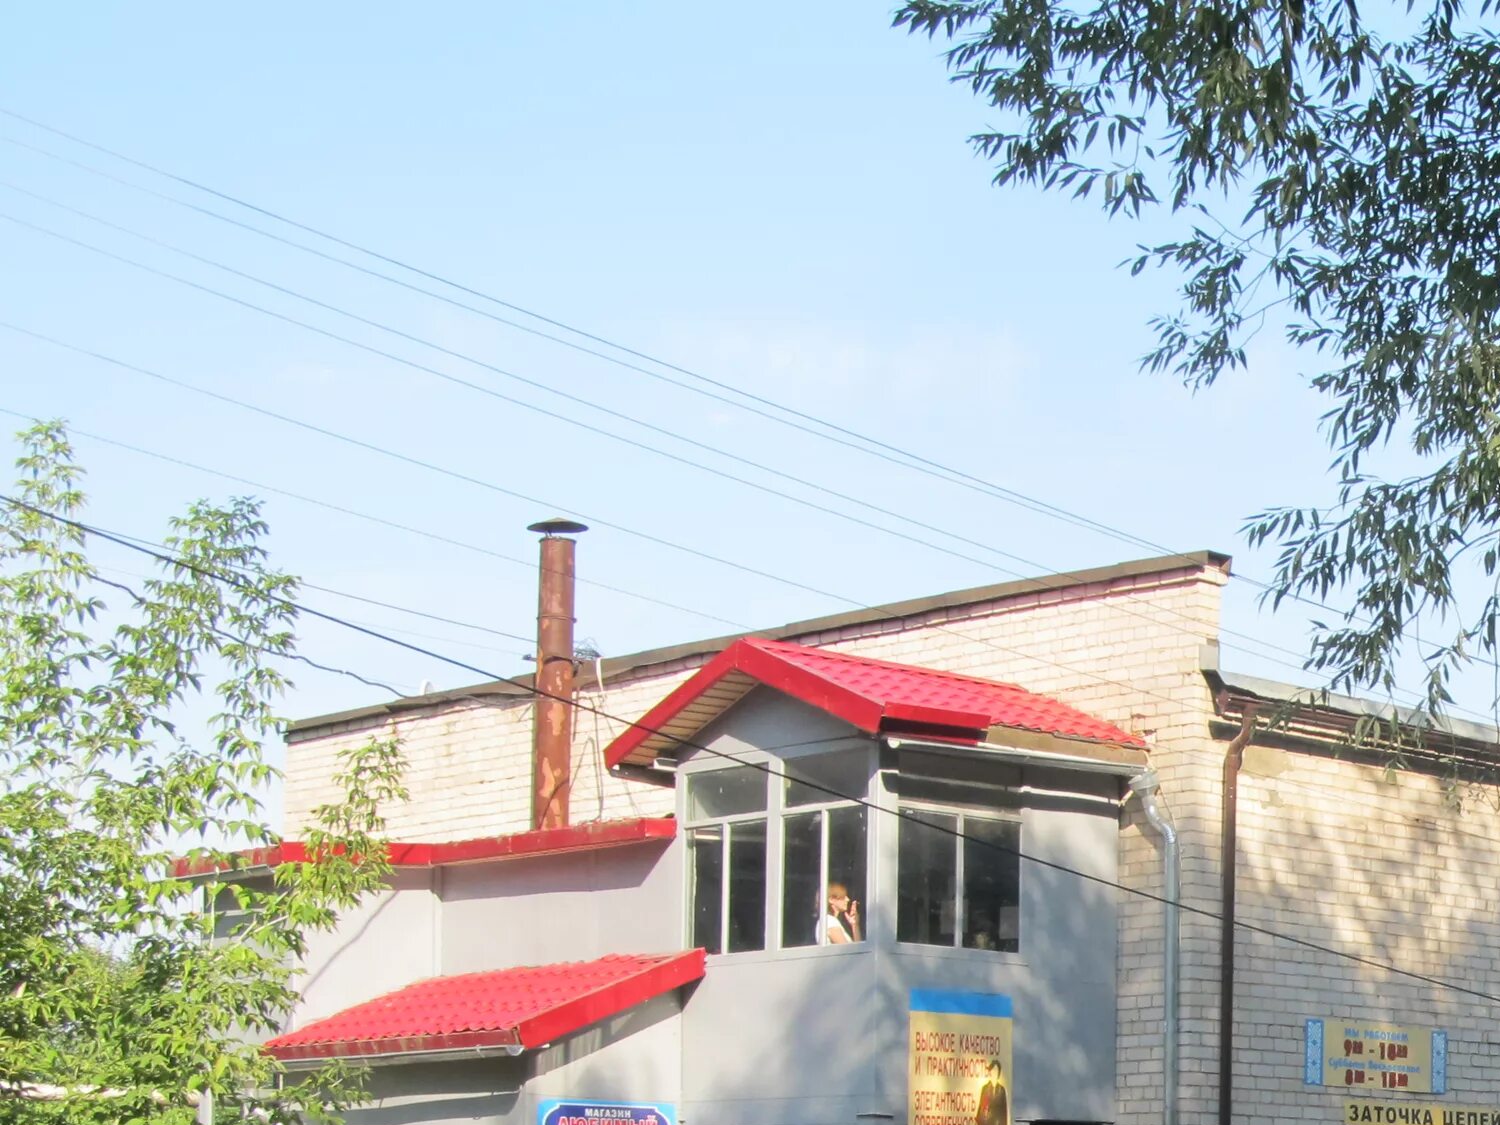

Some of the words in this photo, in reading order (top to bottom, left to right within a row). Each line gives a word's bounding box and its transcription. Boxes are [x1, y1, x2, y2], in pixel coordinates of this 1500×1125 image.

[916, 1032, 955, 1053] ВЫСОКОЕ
[959, 1035, 1000, 1055] КАЧЕСТВО
[915, 1057, 921, 1075] И
[926, 1056, 992, 1079] ПРАКТИЧНОСТЬ
[914, 1091, 976, 1112] ЭЛЕГАНТНОСТЬ
[585, 1108, 631, 1118] МАГАЗИН
[1350, 1105, 1433, 1125] ЗАТОЧКА
